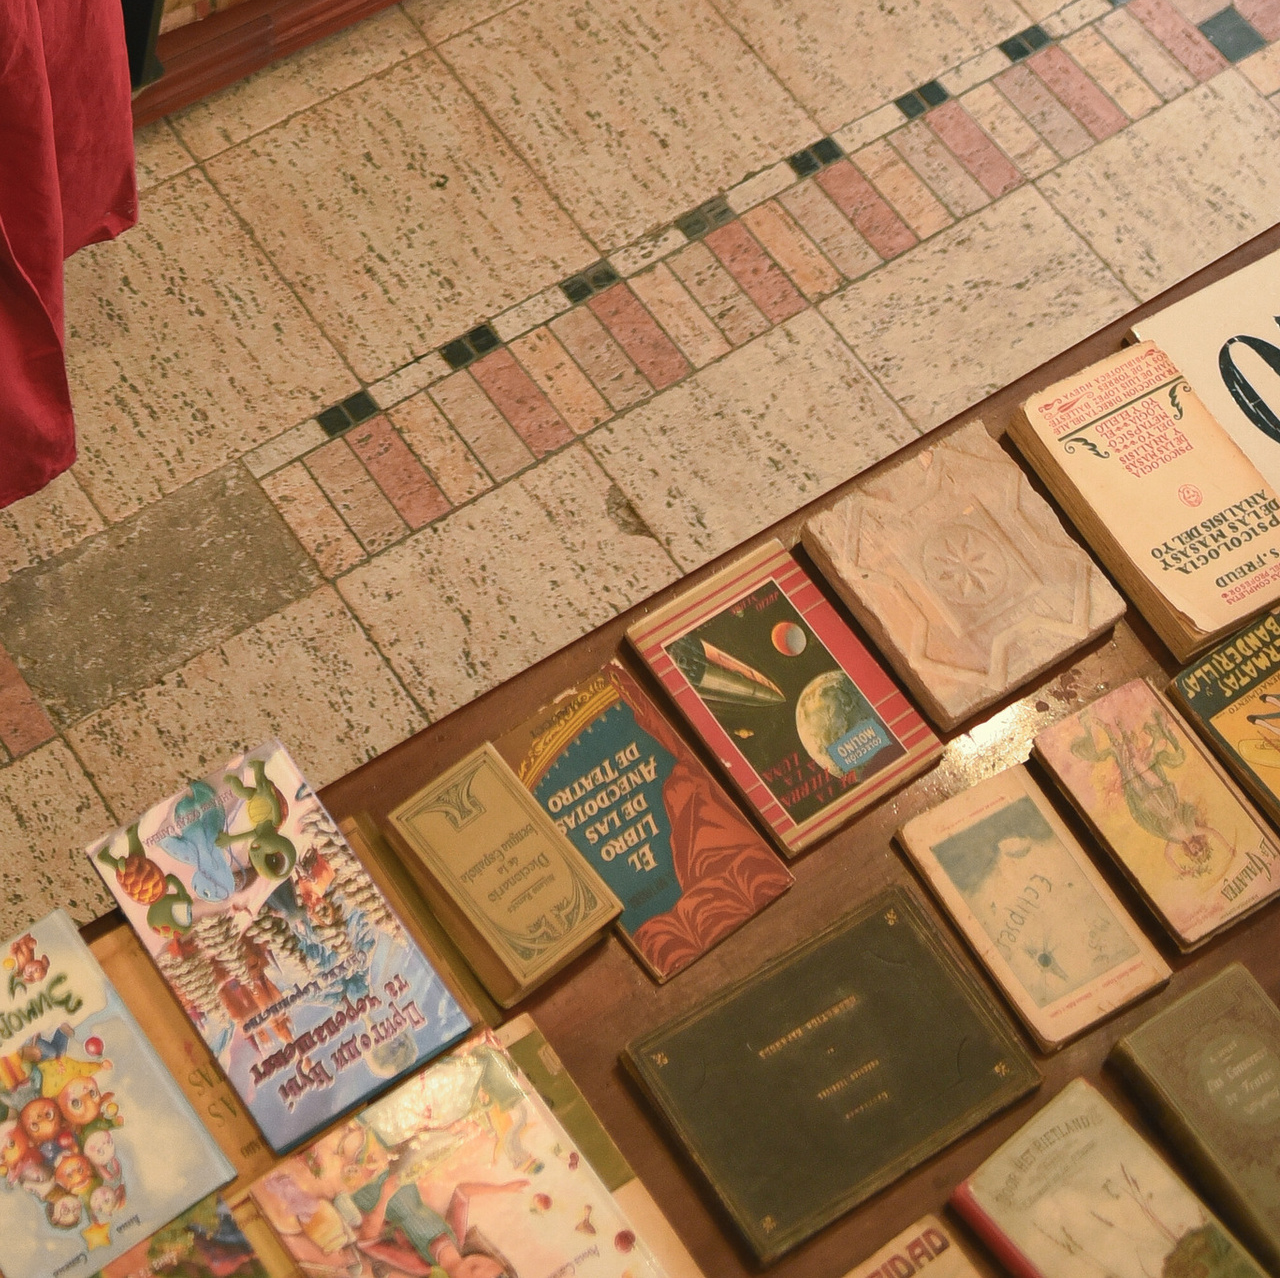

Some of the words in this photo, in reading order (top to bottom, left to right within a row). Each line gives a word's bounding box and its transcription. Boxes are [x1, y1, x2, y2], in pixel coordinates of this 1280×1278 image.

[1093, 355, 1141, 385] BIBLIOTECA
[1129, 364, 1143, 375] DE
[1140, 368, 1152, 379] DE
[1142, 360, 1151, 368] Y
[1062, 380, 1092, 401] NUEVA
[1096, 370, 1130, 392] TORRES
[1119, 374, 1141, 390] LUIS
[1084, 394, 1122, 419] DIRECTA
[1127, 402, 1163, 426] LOGIA
[1129, 405, 1139, 415] Y
[1139, 396, 1156, 410] YO
[1099, 428, 1115, 441] EL
[1135, 429, 1153, 444] YO
[1151, 417, 1174, 435] DEL
[1170, 426, 1180, 436] Y
[1155, 439, 1175, 455] LAS
[1172, 432, 1187, 446] DE
[1123, 449, 1158, 472] MASAS
[1130, 440, 1193, 480] PSICOLOGIA
[1258, 498, 1280, 516] DE
[1226, 508, 1262, 534] LAS
[1170, 525, 1201, 549] DEL
[1174, 512, 1280, 579] PSICOLOGIA
[1149, 540, 1173, 560] YO
[1179, 614, 1280, 699] BANDERILLAS
[835, 724, 877, 759] MOLINO
[613, 740, 642, 770] DE
[544, 757, 619, 815] TEATRO
[554, 755, 663, 836] ANÉCDOTAS
[618, 792, 650, 822] DE
[582, 808, 623, 845] LAS
[597, 811, 661, 864] LIBRO
[496, 863, 509, 877] la
[506, 854, 520, 869] de
[624, 842, 660, 878] EL
[485, 850, 550, 905] Diccionario
[993, 874, 1054, 953] Eclipses
[381, 970, 409, 1000] та
[326, 993, 427, 1076] Пригоди
